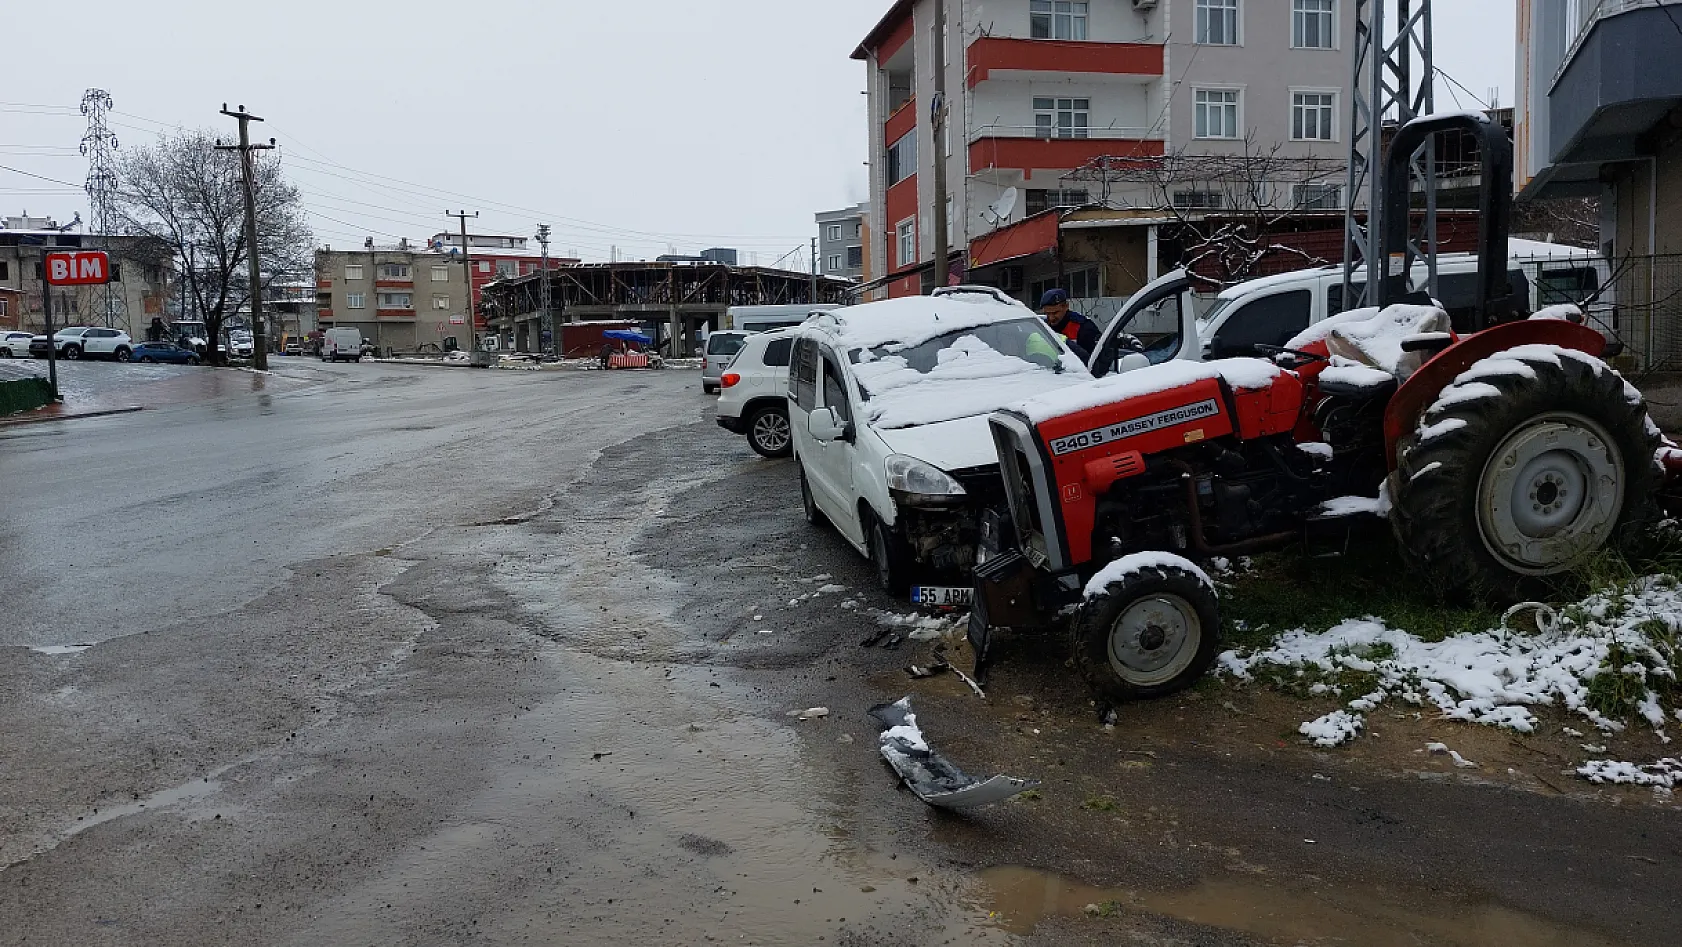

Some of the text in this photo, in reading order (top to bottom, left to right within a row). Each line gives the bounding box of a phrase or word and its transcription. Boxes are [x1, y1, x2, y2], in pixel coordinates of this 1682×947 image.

[1055, 402, 1213, 453] 240 S MASSEY FERGUSON
[920, 587, 937, 603] 55
